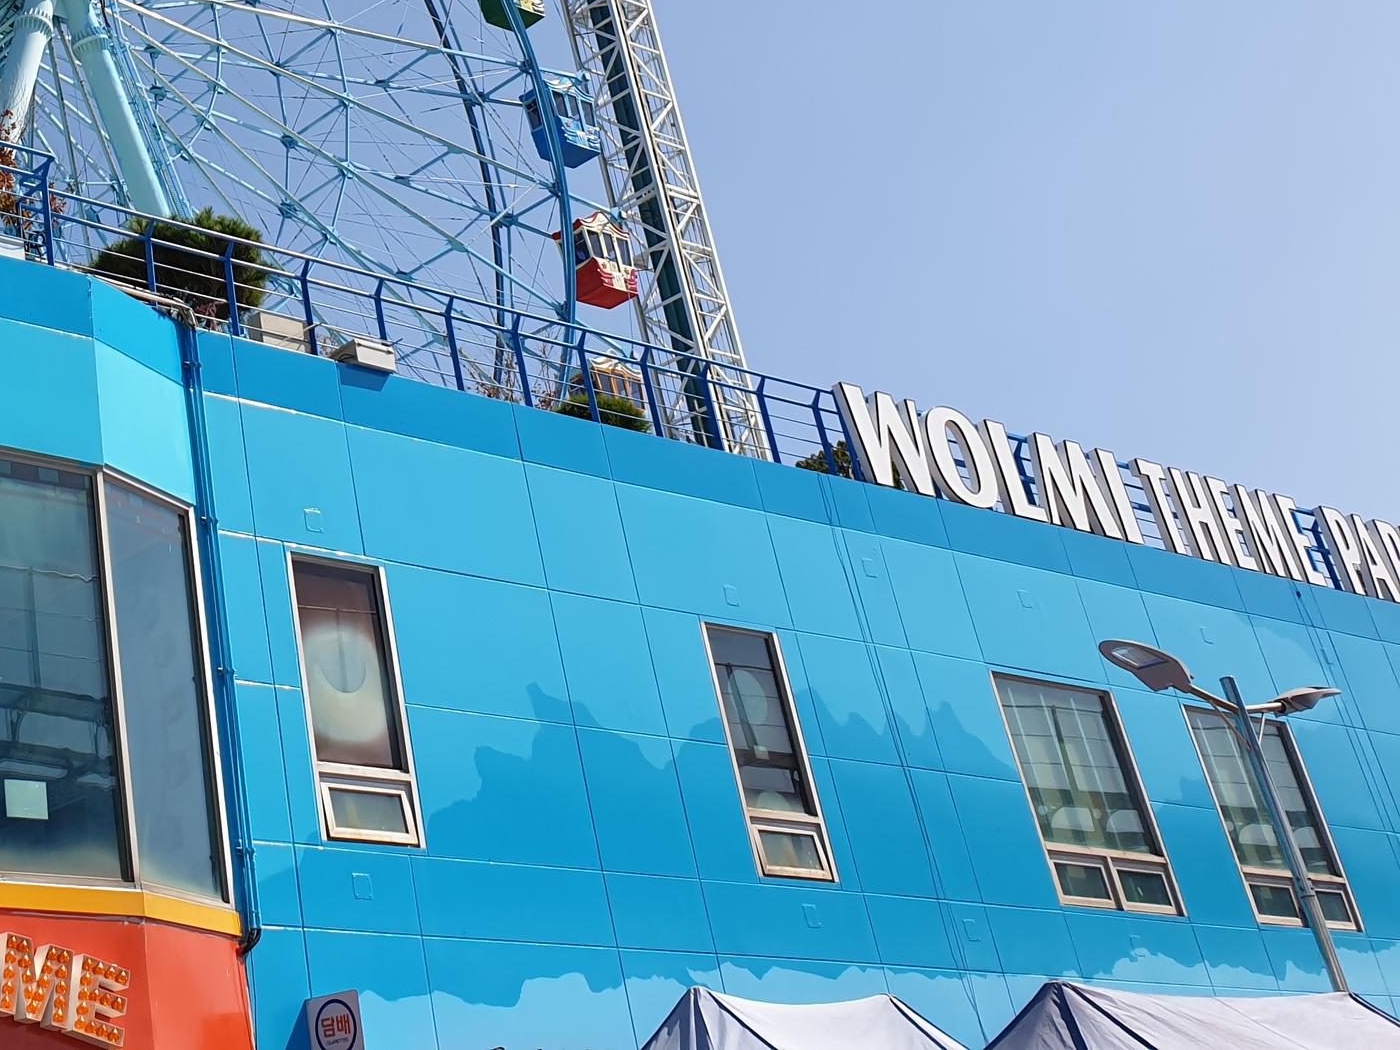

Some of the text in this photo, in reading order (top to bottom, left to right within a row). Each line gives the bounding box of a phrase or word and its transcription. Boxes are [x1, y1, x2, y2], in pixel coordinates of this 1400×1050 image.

[833, 382, 1145, 545] WOLMI
[1129, 458, 1328, 588] THEME
[321, 1014, 351, 1038] 담배
